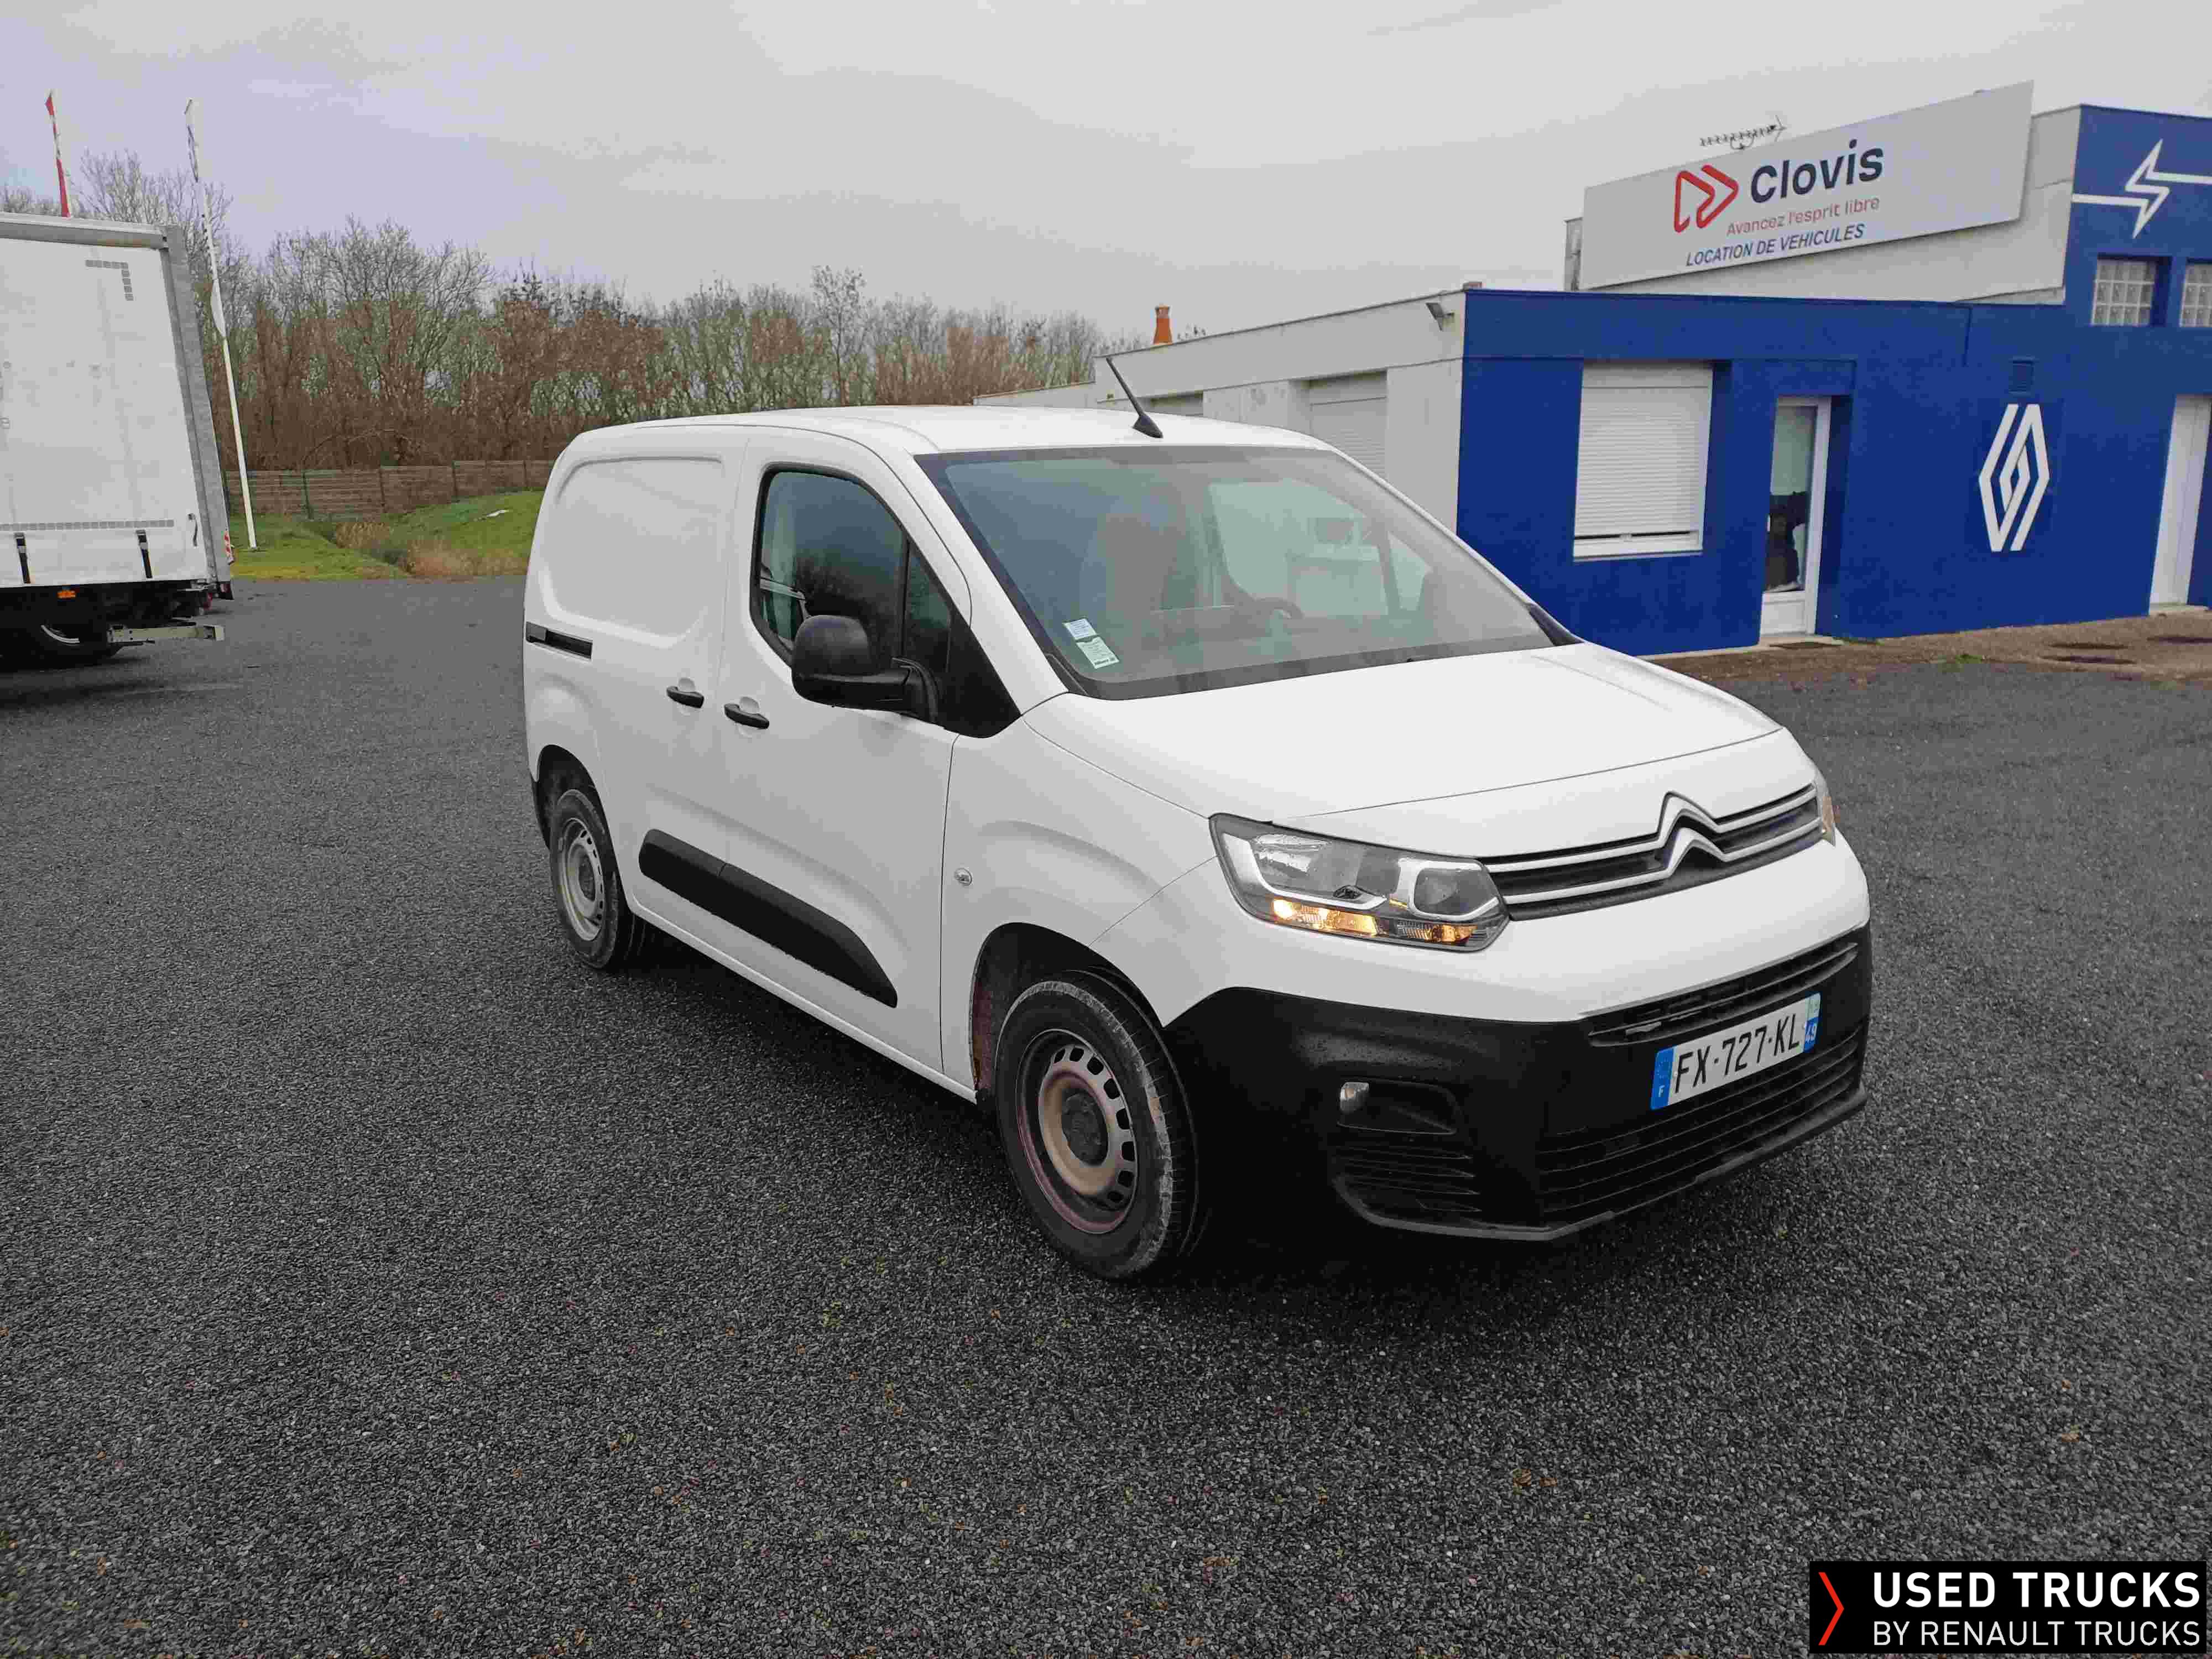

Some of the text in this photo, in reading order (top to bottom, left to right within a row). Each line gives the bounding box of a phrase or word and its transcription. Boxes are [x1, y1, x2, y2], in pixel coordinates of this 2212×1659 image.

[1750, 139, 1884, 204] Clovis
[1726, 196, 1880, 237] Avancez l'esprit libre
[1686, 223, 1865, 267] LOCATION DE VEHICULES
